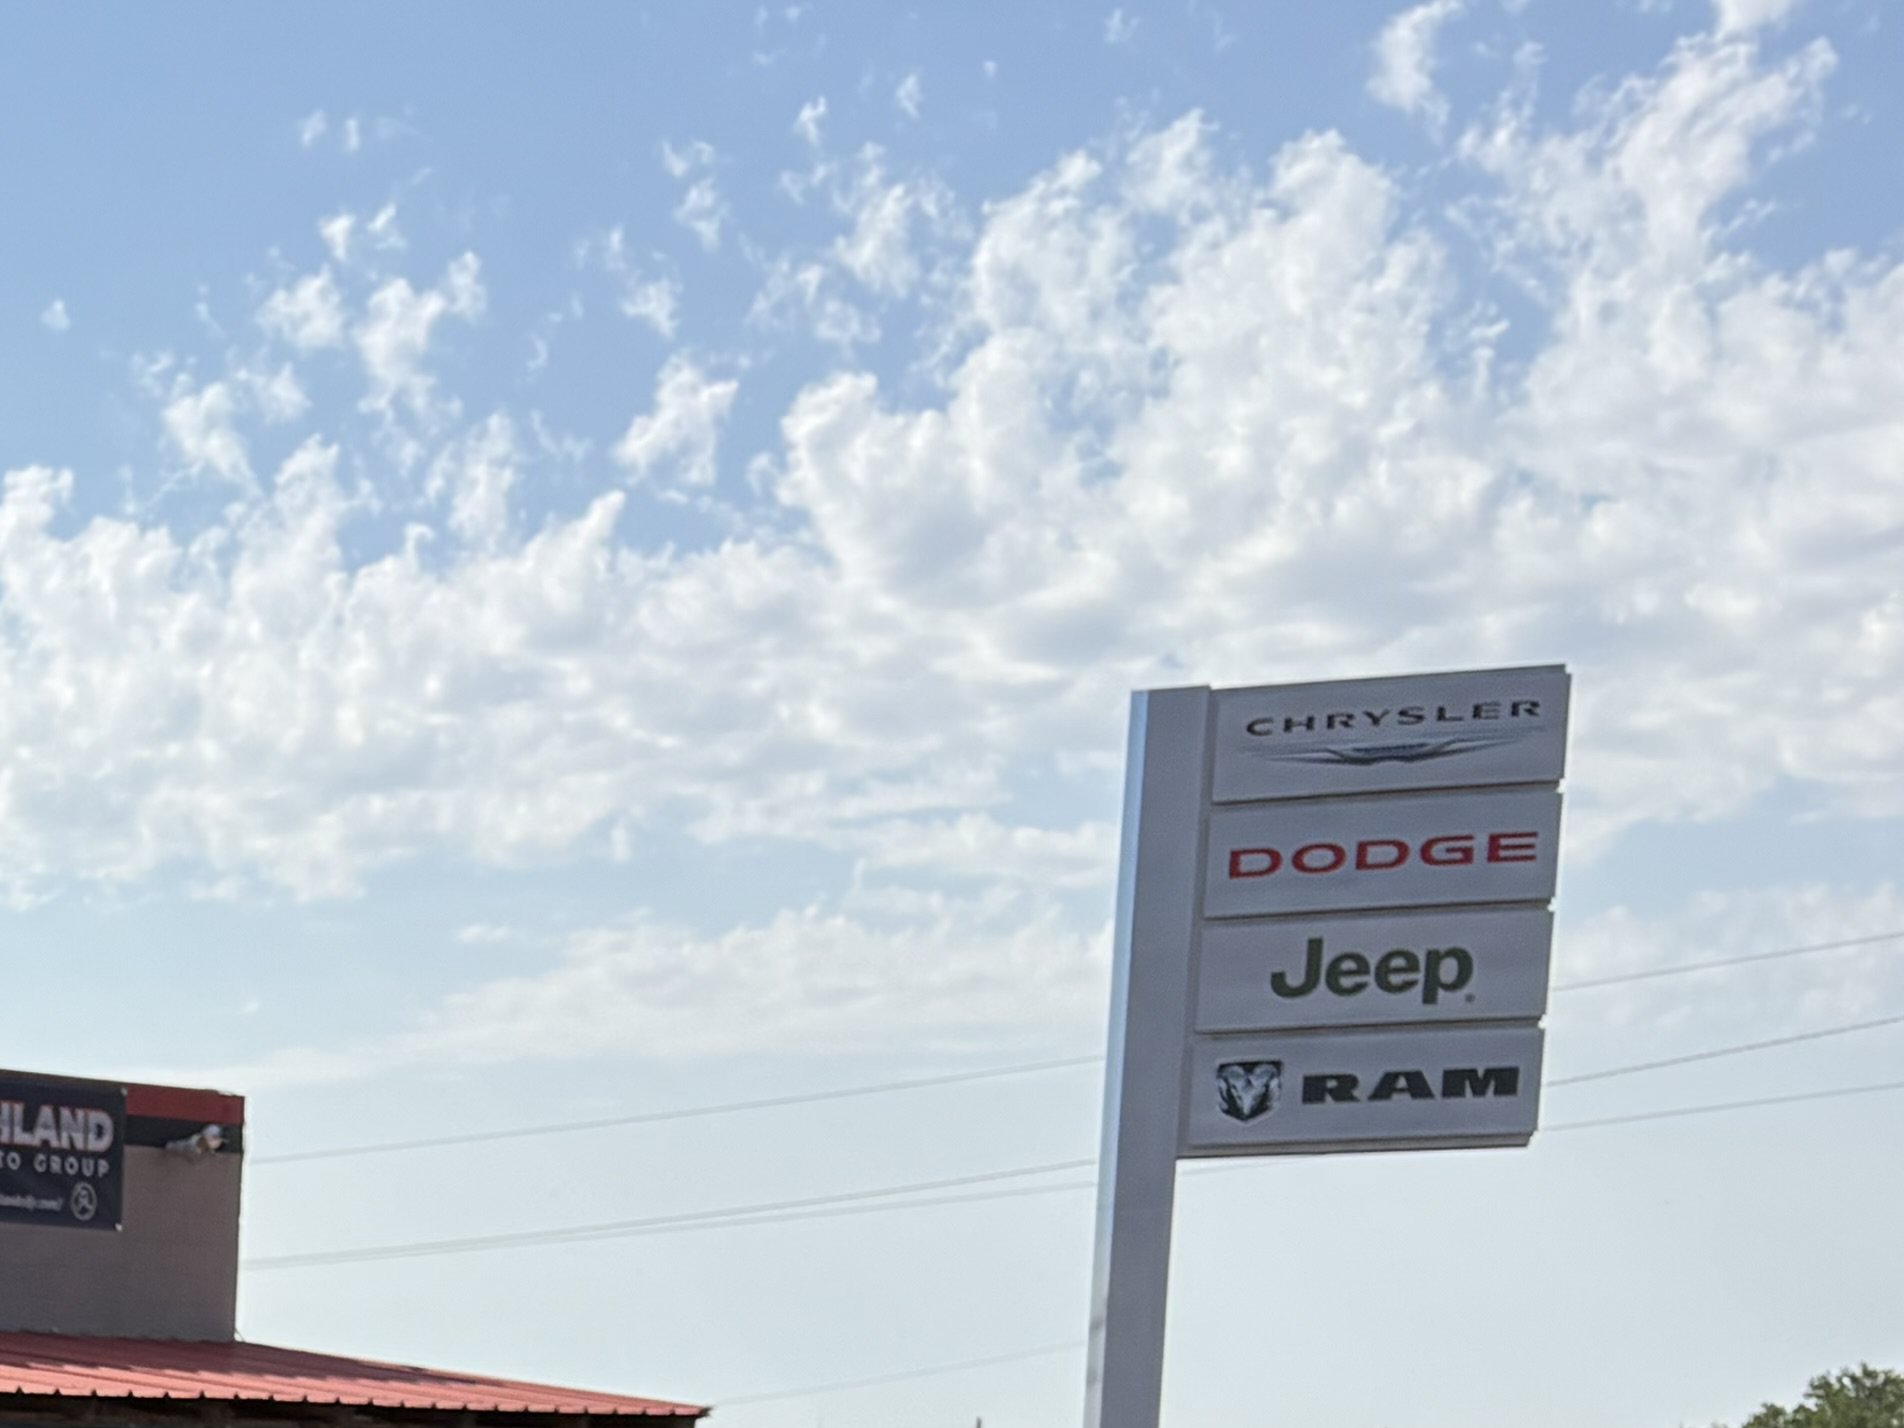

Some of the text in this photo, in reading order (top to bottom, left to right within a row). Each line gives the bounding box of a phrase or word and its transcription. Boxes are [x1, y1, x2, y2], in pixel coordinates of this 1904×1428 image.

[1245, 700, 1541, 737] CHRYSLER
[1228, 831, 1539, 880] DODGE
[1270, 937, 1475, 1006] Jeep
[1301, 1066, 1520, 1105] RAM
[33, 1153, 110, 1179] GROUP
